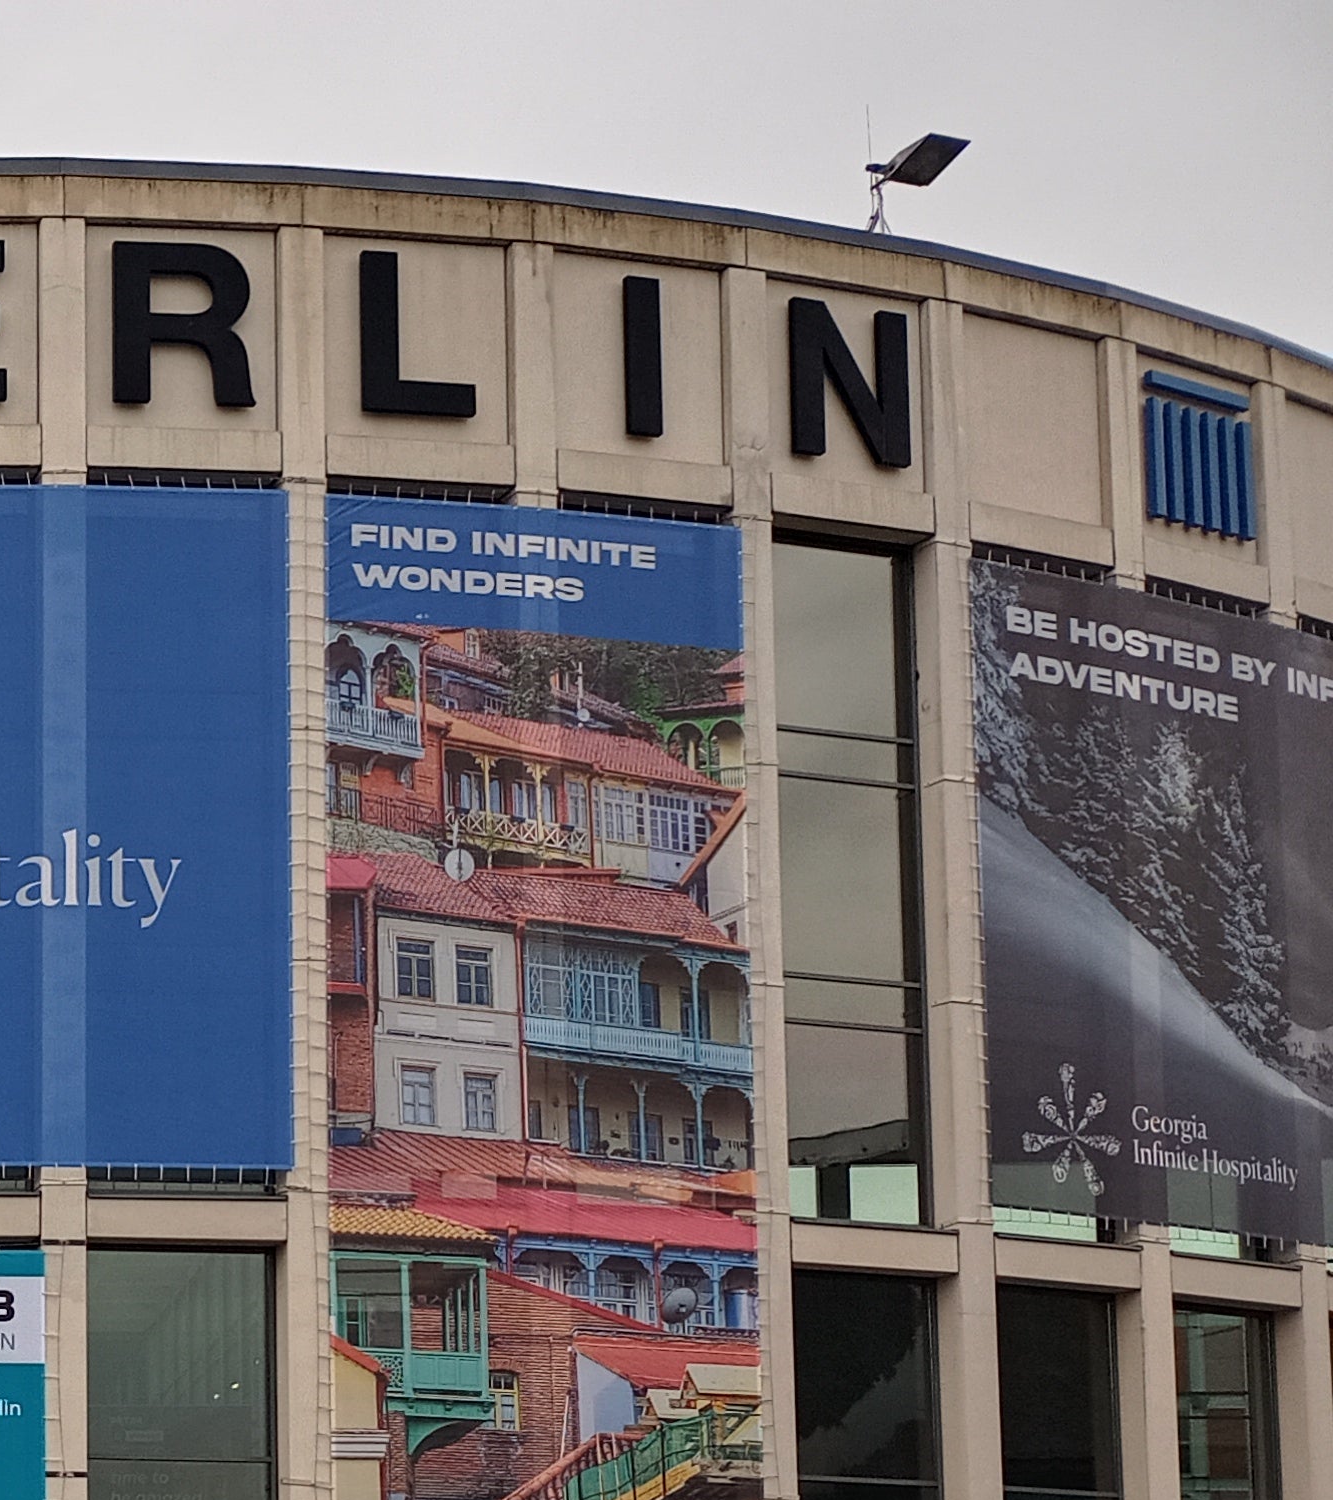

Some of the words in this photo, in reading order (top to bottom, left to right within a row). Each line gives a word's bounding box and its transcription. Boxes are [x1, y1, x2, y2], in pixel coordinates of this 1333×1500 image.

[351, 523, 456, 553] FIND
[472, 531, 656, 570] INFINITE
[352, 563, 584, 602] WONDERS
[1006, 606, 1058, 640] BE
[1069, 617, 1221, 674] HOSTED
[1231, 653, 1276, 686] BY
[1009, 652, 1238, 722] ADVENTURE
[1131, 1106, 1207, 1144] Georgia
[1133, 1139, 1199, 1172] Infinite
[1203, 1147, 1298, 1192] Hospitality
